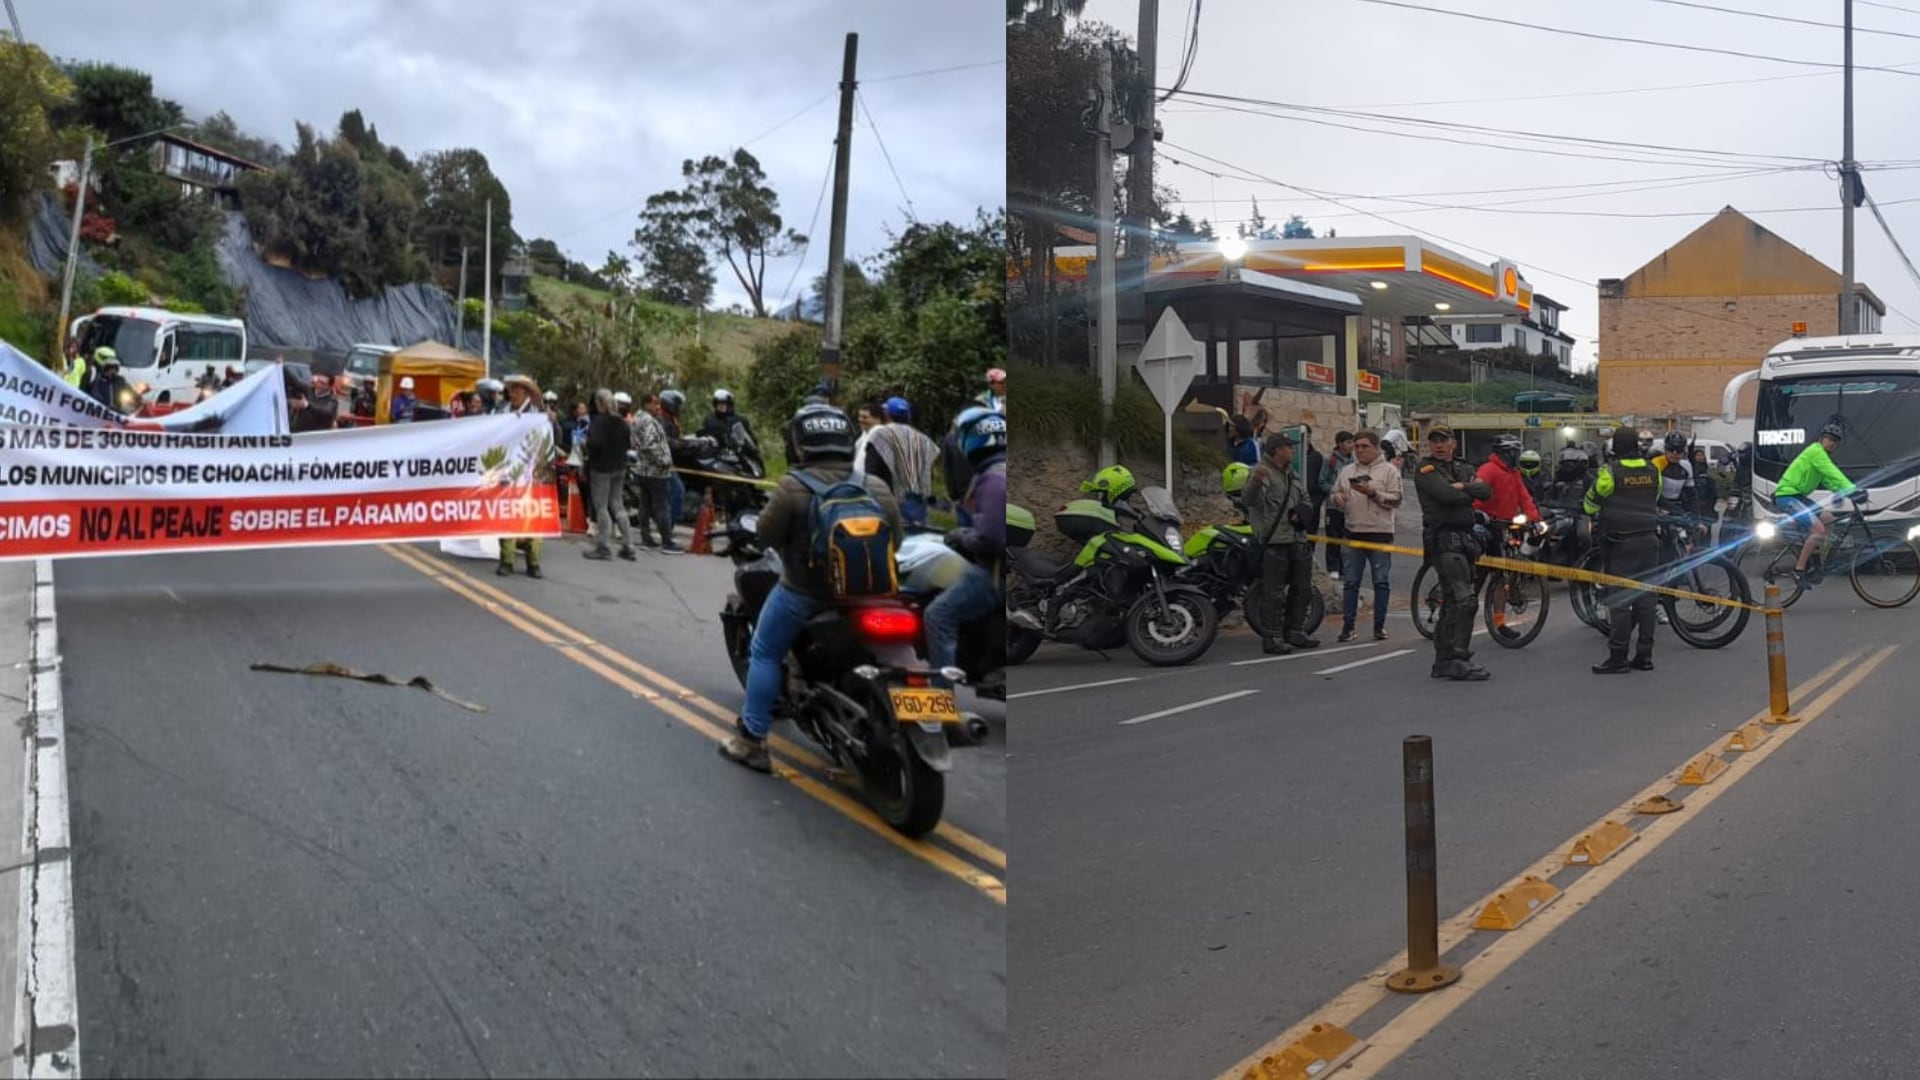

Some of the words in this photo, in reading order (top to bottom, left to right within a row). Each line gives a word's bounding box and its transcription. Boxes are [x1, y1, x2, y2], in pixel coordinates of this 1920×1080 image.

[64, 429, 95, 449] DE
[0, 464, 38, 486] LOS
[41, 464, 168, 486] MUNICIPIOS
[172, 464, 199, 484] DE
[298, 456, 390, 481] FÓMEQUE
[392, 459, 404, 478] Y
[407, 457, 478, 477] UBAQUE
[79, 506, 113, 542] NO
[115, 506, 147, 541] AL
[150, 504, 223, 540] PEAJE
[229, 508, 303, 532] SOBRE
[306, 506, 331, 528] EL
[334, 498, 428, 527] PÁRAMO
[430, 500, 482, 523] CRUZ
[484, 497, 554, 520] VERDE
